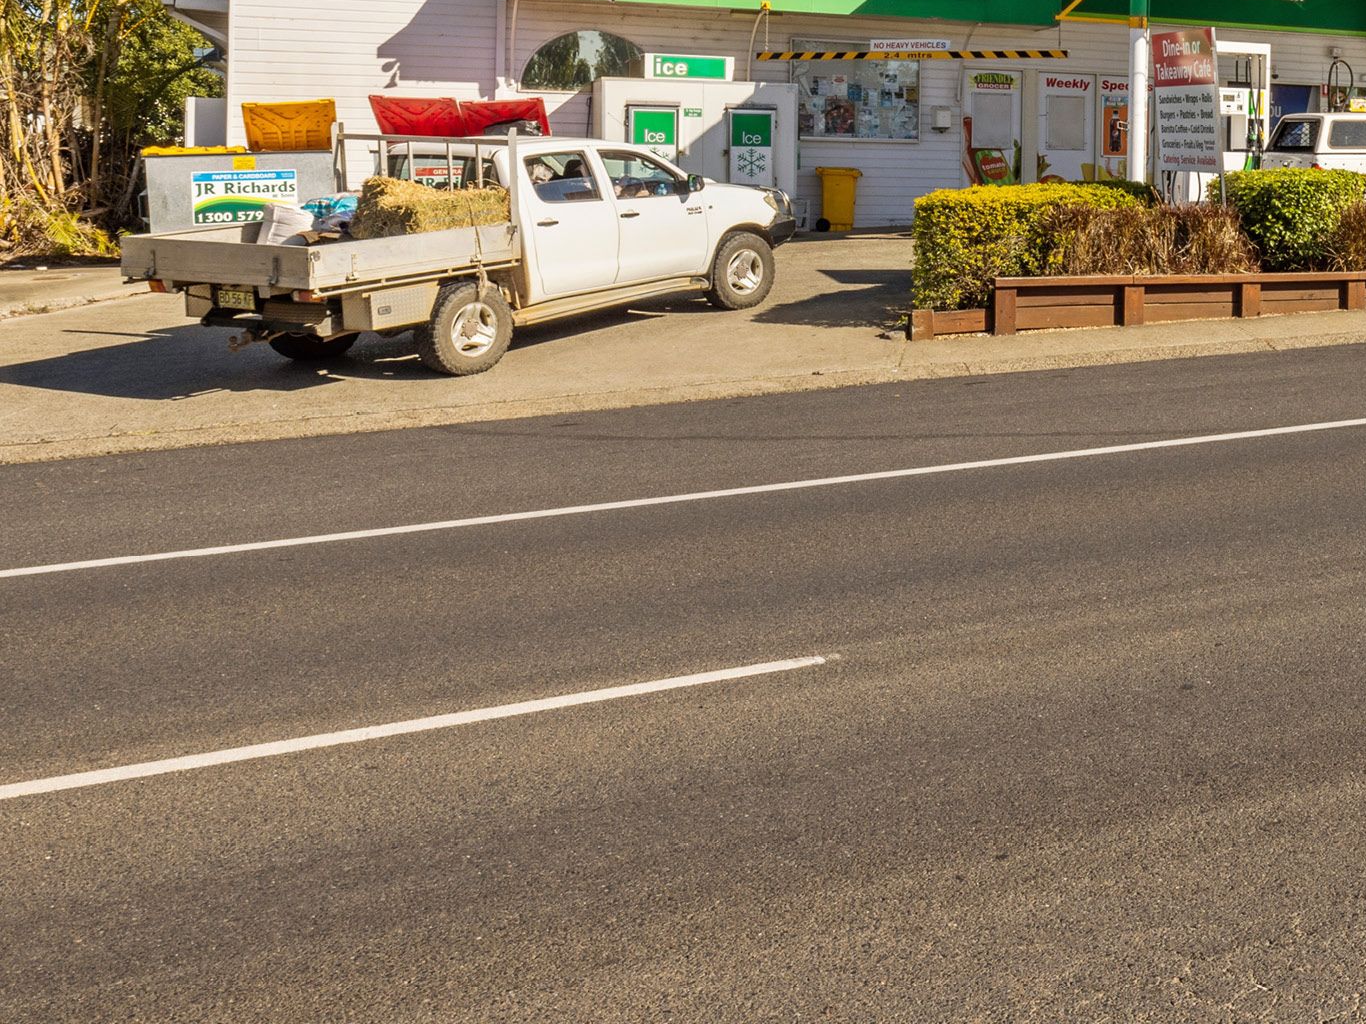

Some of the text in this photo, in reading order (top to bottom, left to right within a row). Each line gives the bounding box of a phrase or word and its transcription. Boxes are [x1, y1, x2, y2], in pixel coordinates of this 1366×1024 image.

[911, 41, 947, 49] VEHICLES
[1162, 38, 1201, 57] Dine-in or
[656, 57, 688, 75] ice
[1156, 59, 1212, 83] Takeaway Café
[1046, 77, 1090, 92] Weekly
[1101, 80, 1153, 93] Specs
[644, 129, 666, 143] Ice
[742, 131, 762, 144] Ice
[195, 180, 296, 197] JR Richards
[197, 210, 264, 223] 1300 579
